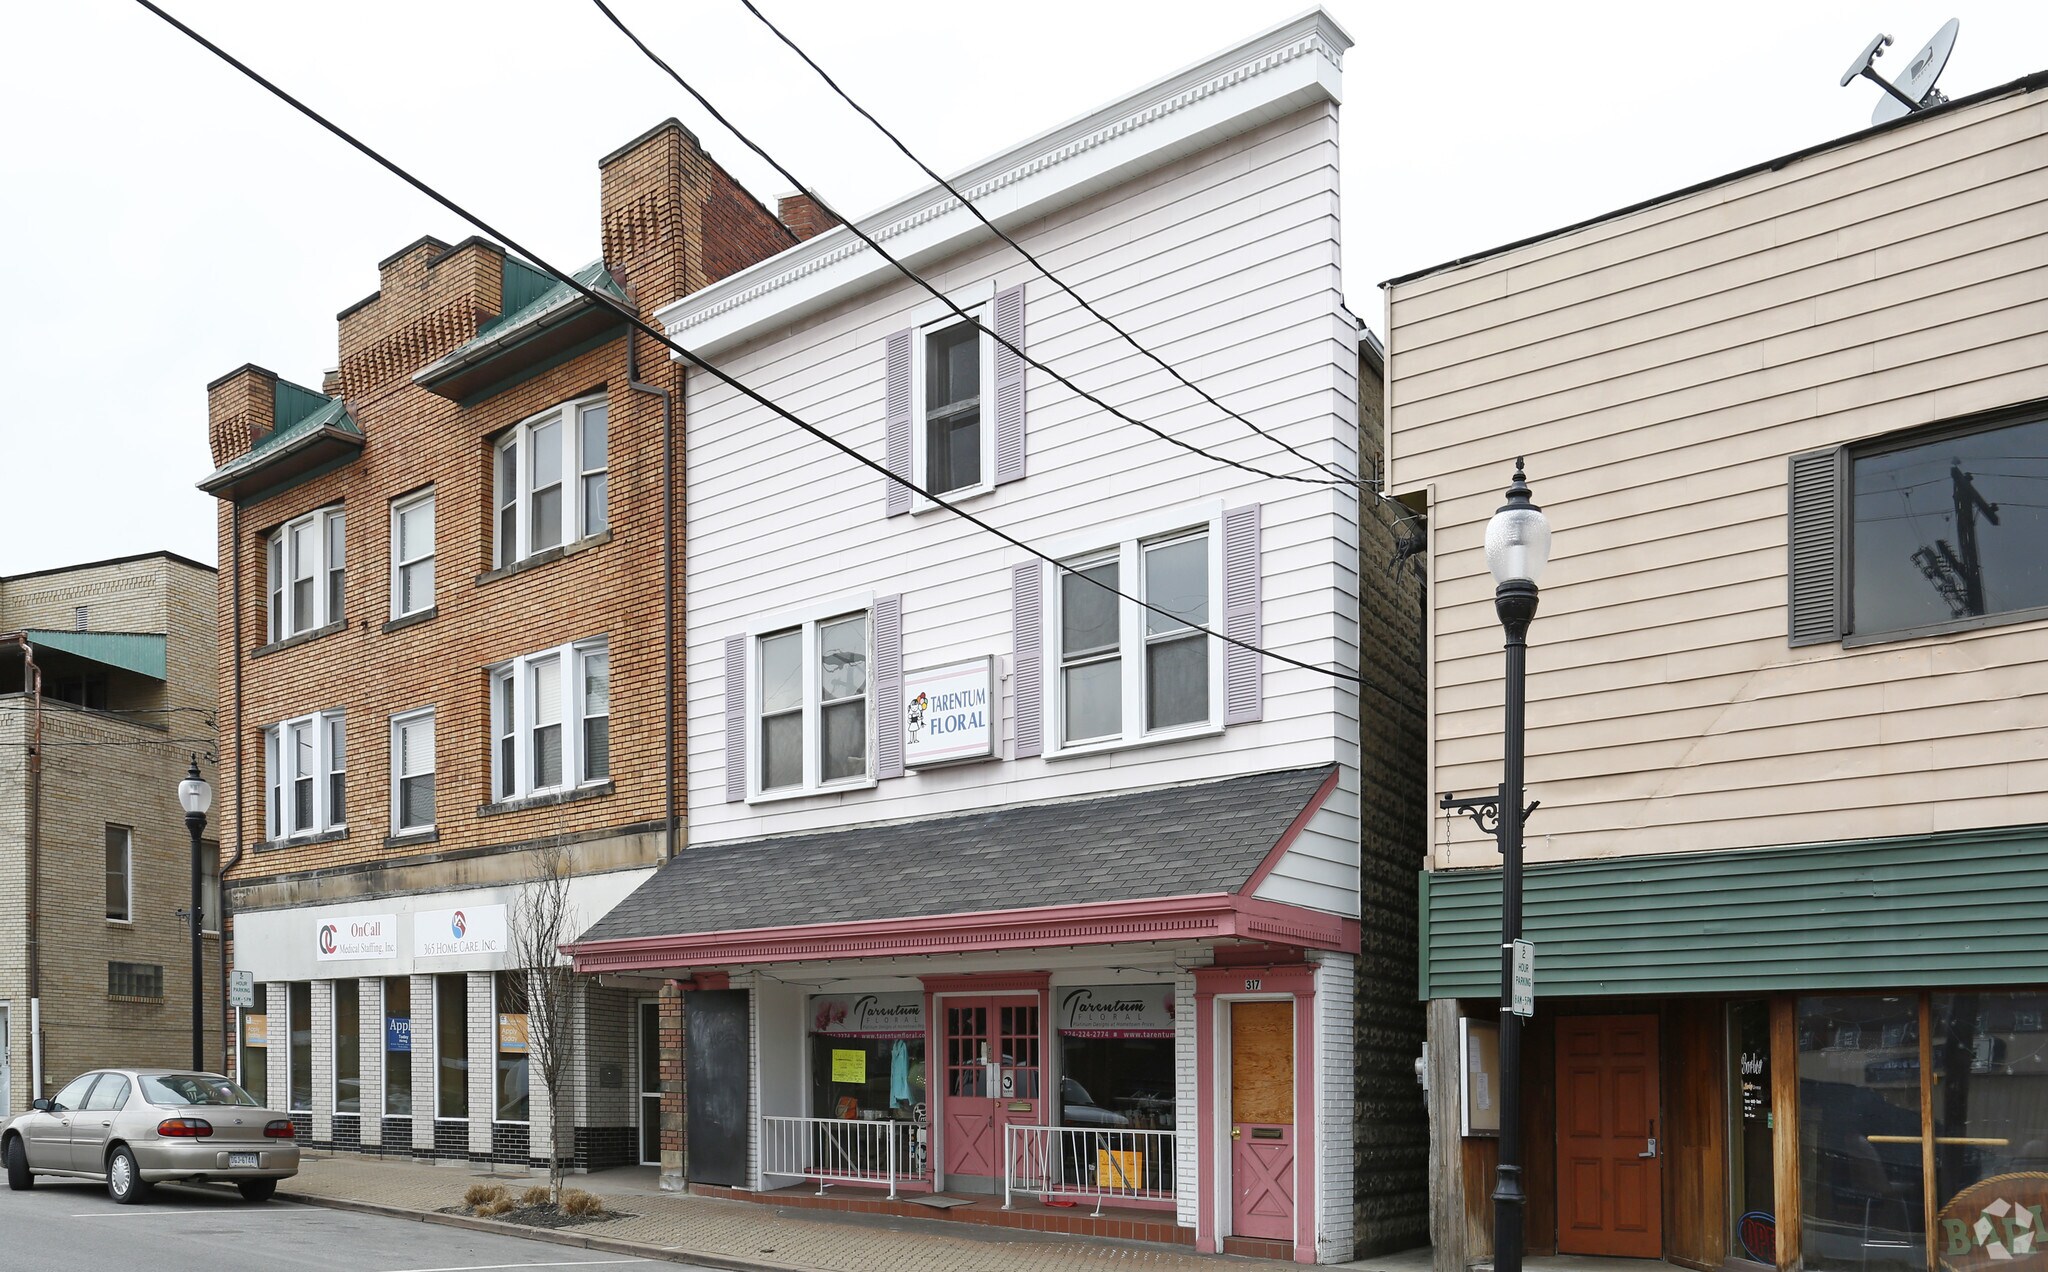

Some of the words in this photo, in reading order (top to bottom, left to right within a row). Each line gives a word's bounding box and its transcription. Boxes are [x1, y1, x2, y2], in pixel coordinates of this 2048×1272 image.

[931, 688, 986, 712] TARENTUM
[931, 711, 985, 735] FLORAL
[351, 922, 381, 937] OnCall
[340, 944, 360, 954] Medical
[385, 942, 396, 952] Inc.
[424, 944, 435, 955] 365
[437, 942, 457, 953] HOME
[1518, 963, 1529, 972] HOUR
[1246, 981, 1260, 990] 317
[1516, 976, 1531, 987] PARKING
[854, 995, 920, 1030] Tarentum
[1063, 989, 1145, 1028] Tarentum
